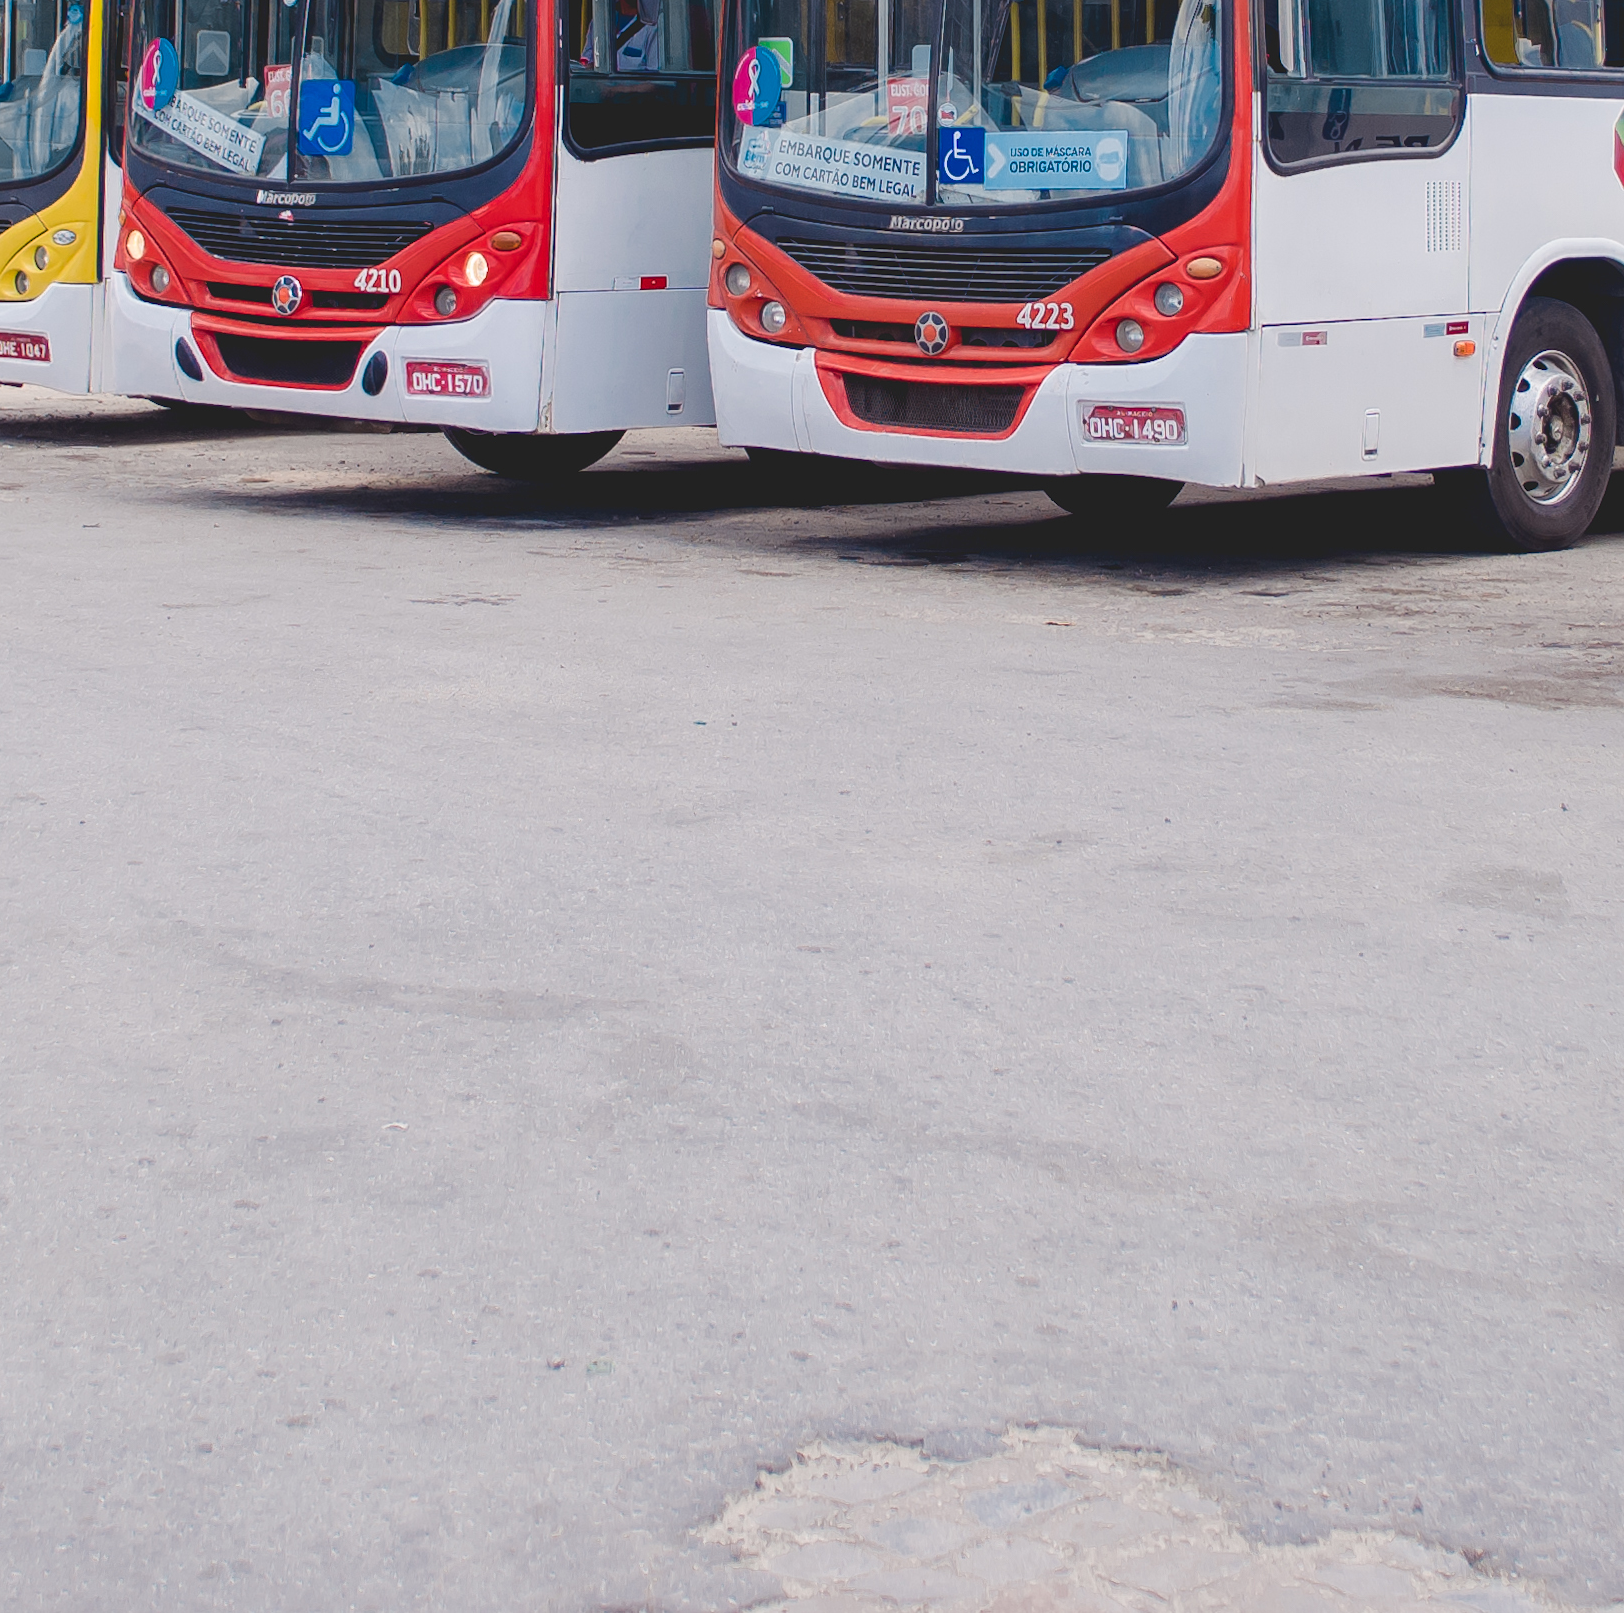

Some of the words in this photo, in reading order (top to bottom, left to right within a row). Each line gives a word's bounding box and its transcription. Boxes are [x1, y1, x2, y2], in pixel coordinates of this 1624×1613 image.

[168, 94, 208, 126] BARQUE
[208, 116, 257, 154] SOMENTE
[203, 135, 222, 155] BEM
[222, 148, 251, 173] LEGAL
[778, 139, 851, 164] EMBARQUE
[853, 151, 921, 177] SOMENTE
[1010, 147, 1030, 157] USO
[1031, 147, 1044, 157] DE
[1045, 144, 1092, 157] MÁSCARA
[1009, 157, 1092, 173] OBRIGATÓRIO
[775, 161, 801, 178] COM
[803, 167, 849, 187] CARTÃO
[852, 175, 876, 191] BEM
[878, 179, 917, 199] LEGAL
[888, 215, 964, 232] Marcopolo
[354, 268, 402, 293] 4210
[1016, 302, 1075, 330] 4223
